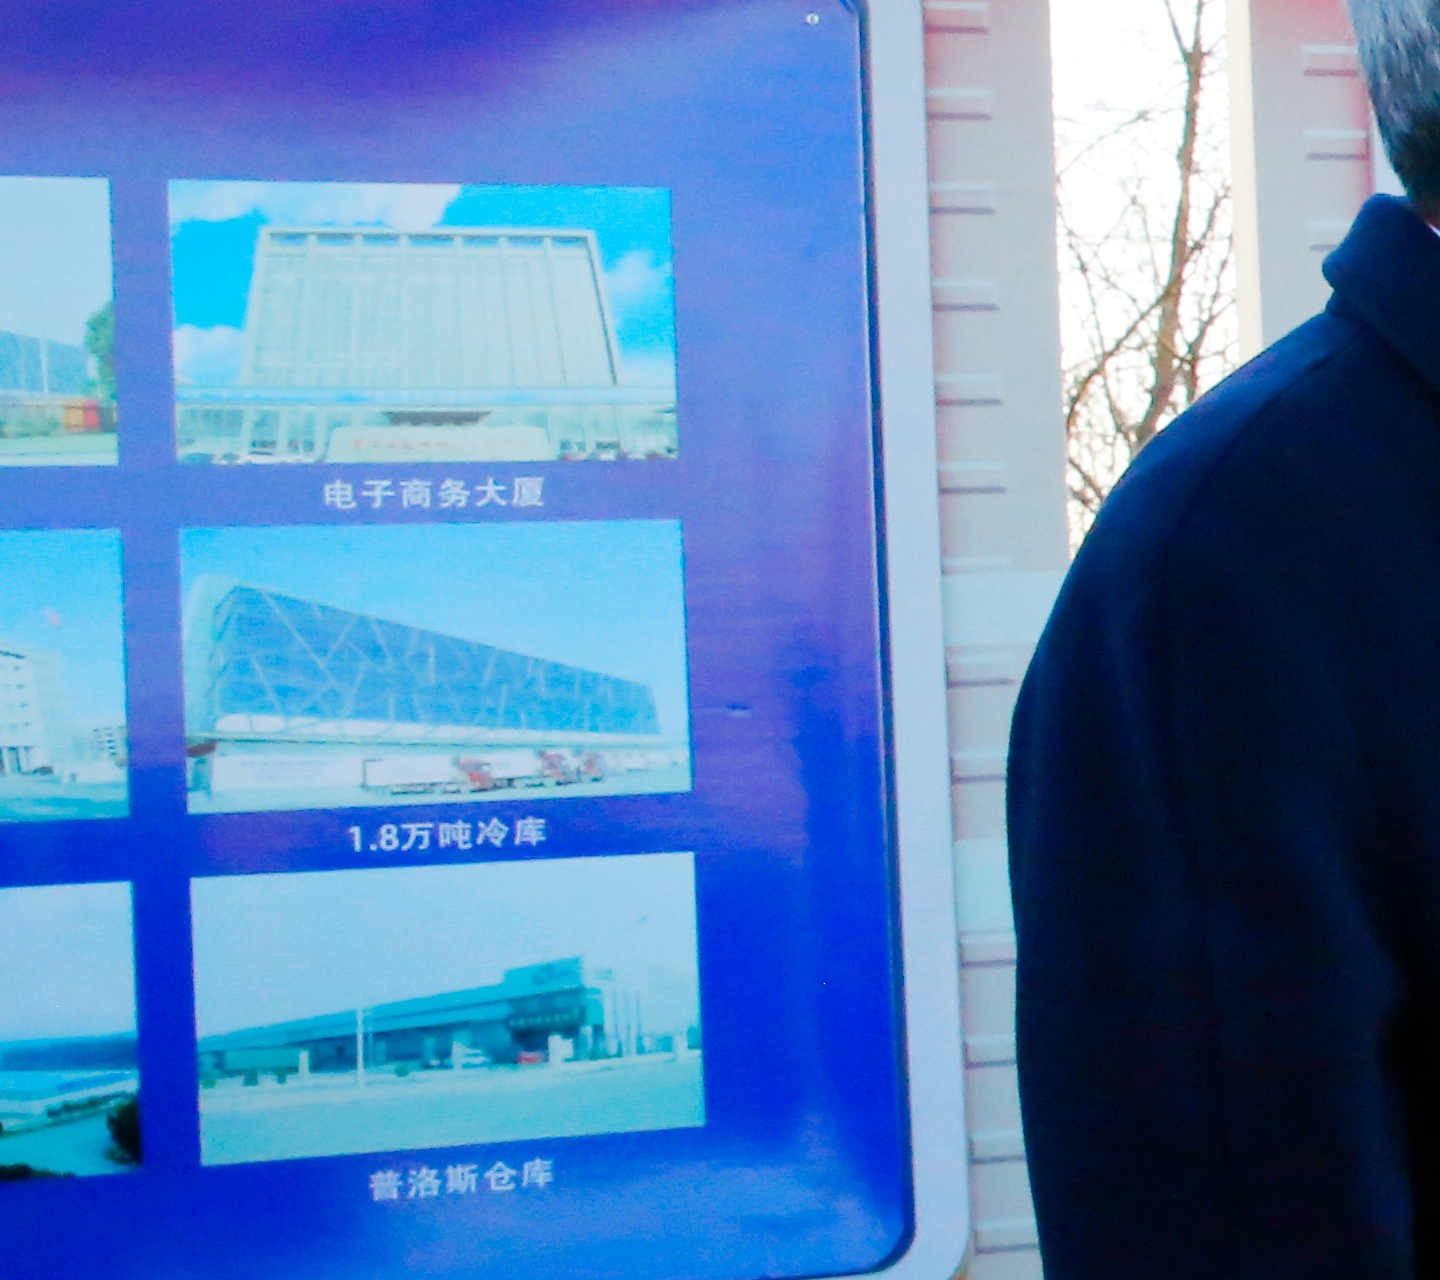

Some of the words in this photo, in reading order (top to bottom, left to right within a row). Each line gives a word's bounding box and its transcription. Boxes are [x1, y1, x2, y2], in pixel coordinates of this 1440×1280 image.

[323, 476, 546, 510] 电子商务大厦
[347, 816, 548, 854] 1.8万吨冷库
[369, 1158, 556, 1202] 普洛斯仓库
